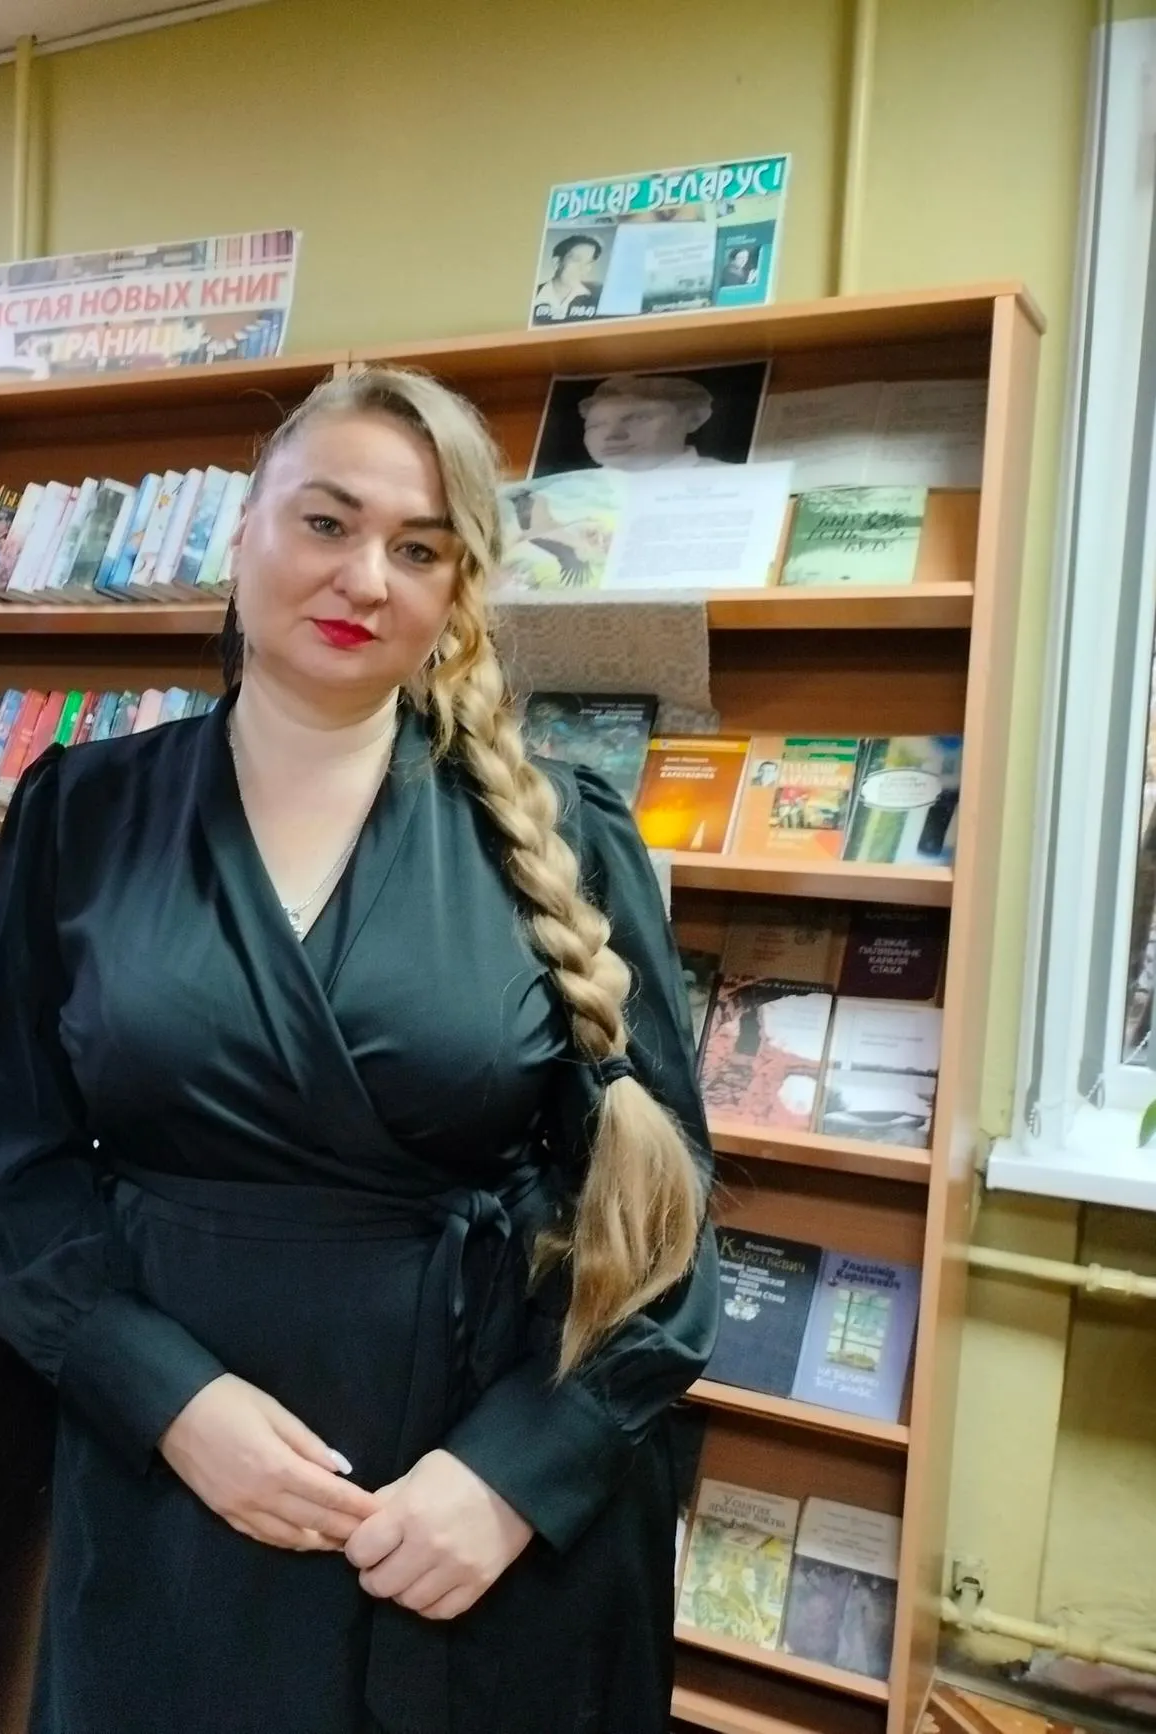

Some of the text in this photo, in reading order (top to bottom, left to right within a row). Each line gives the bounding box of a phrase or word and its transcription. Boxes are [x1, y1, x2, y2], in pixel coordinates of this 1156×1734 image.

[552, 182, 639, 221] РЫЦАР
[79, 281, 191, 316] НОВЫХ
[200, 271, 289, 307] КНИГ
